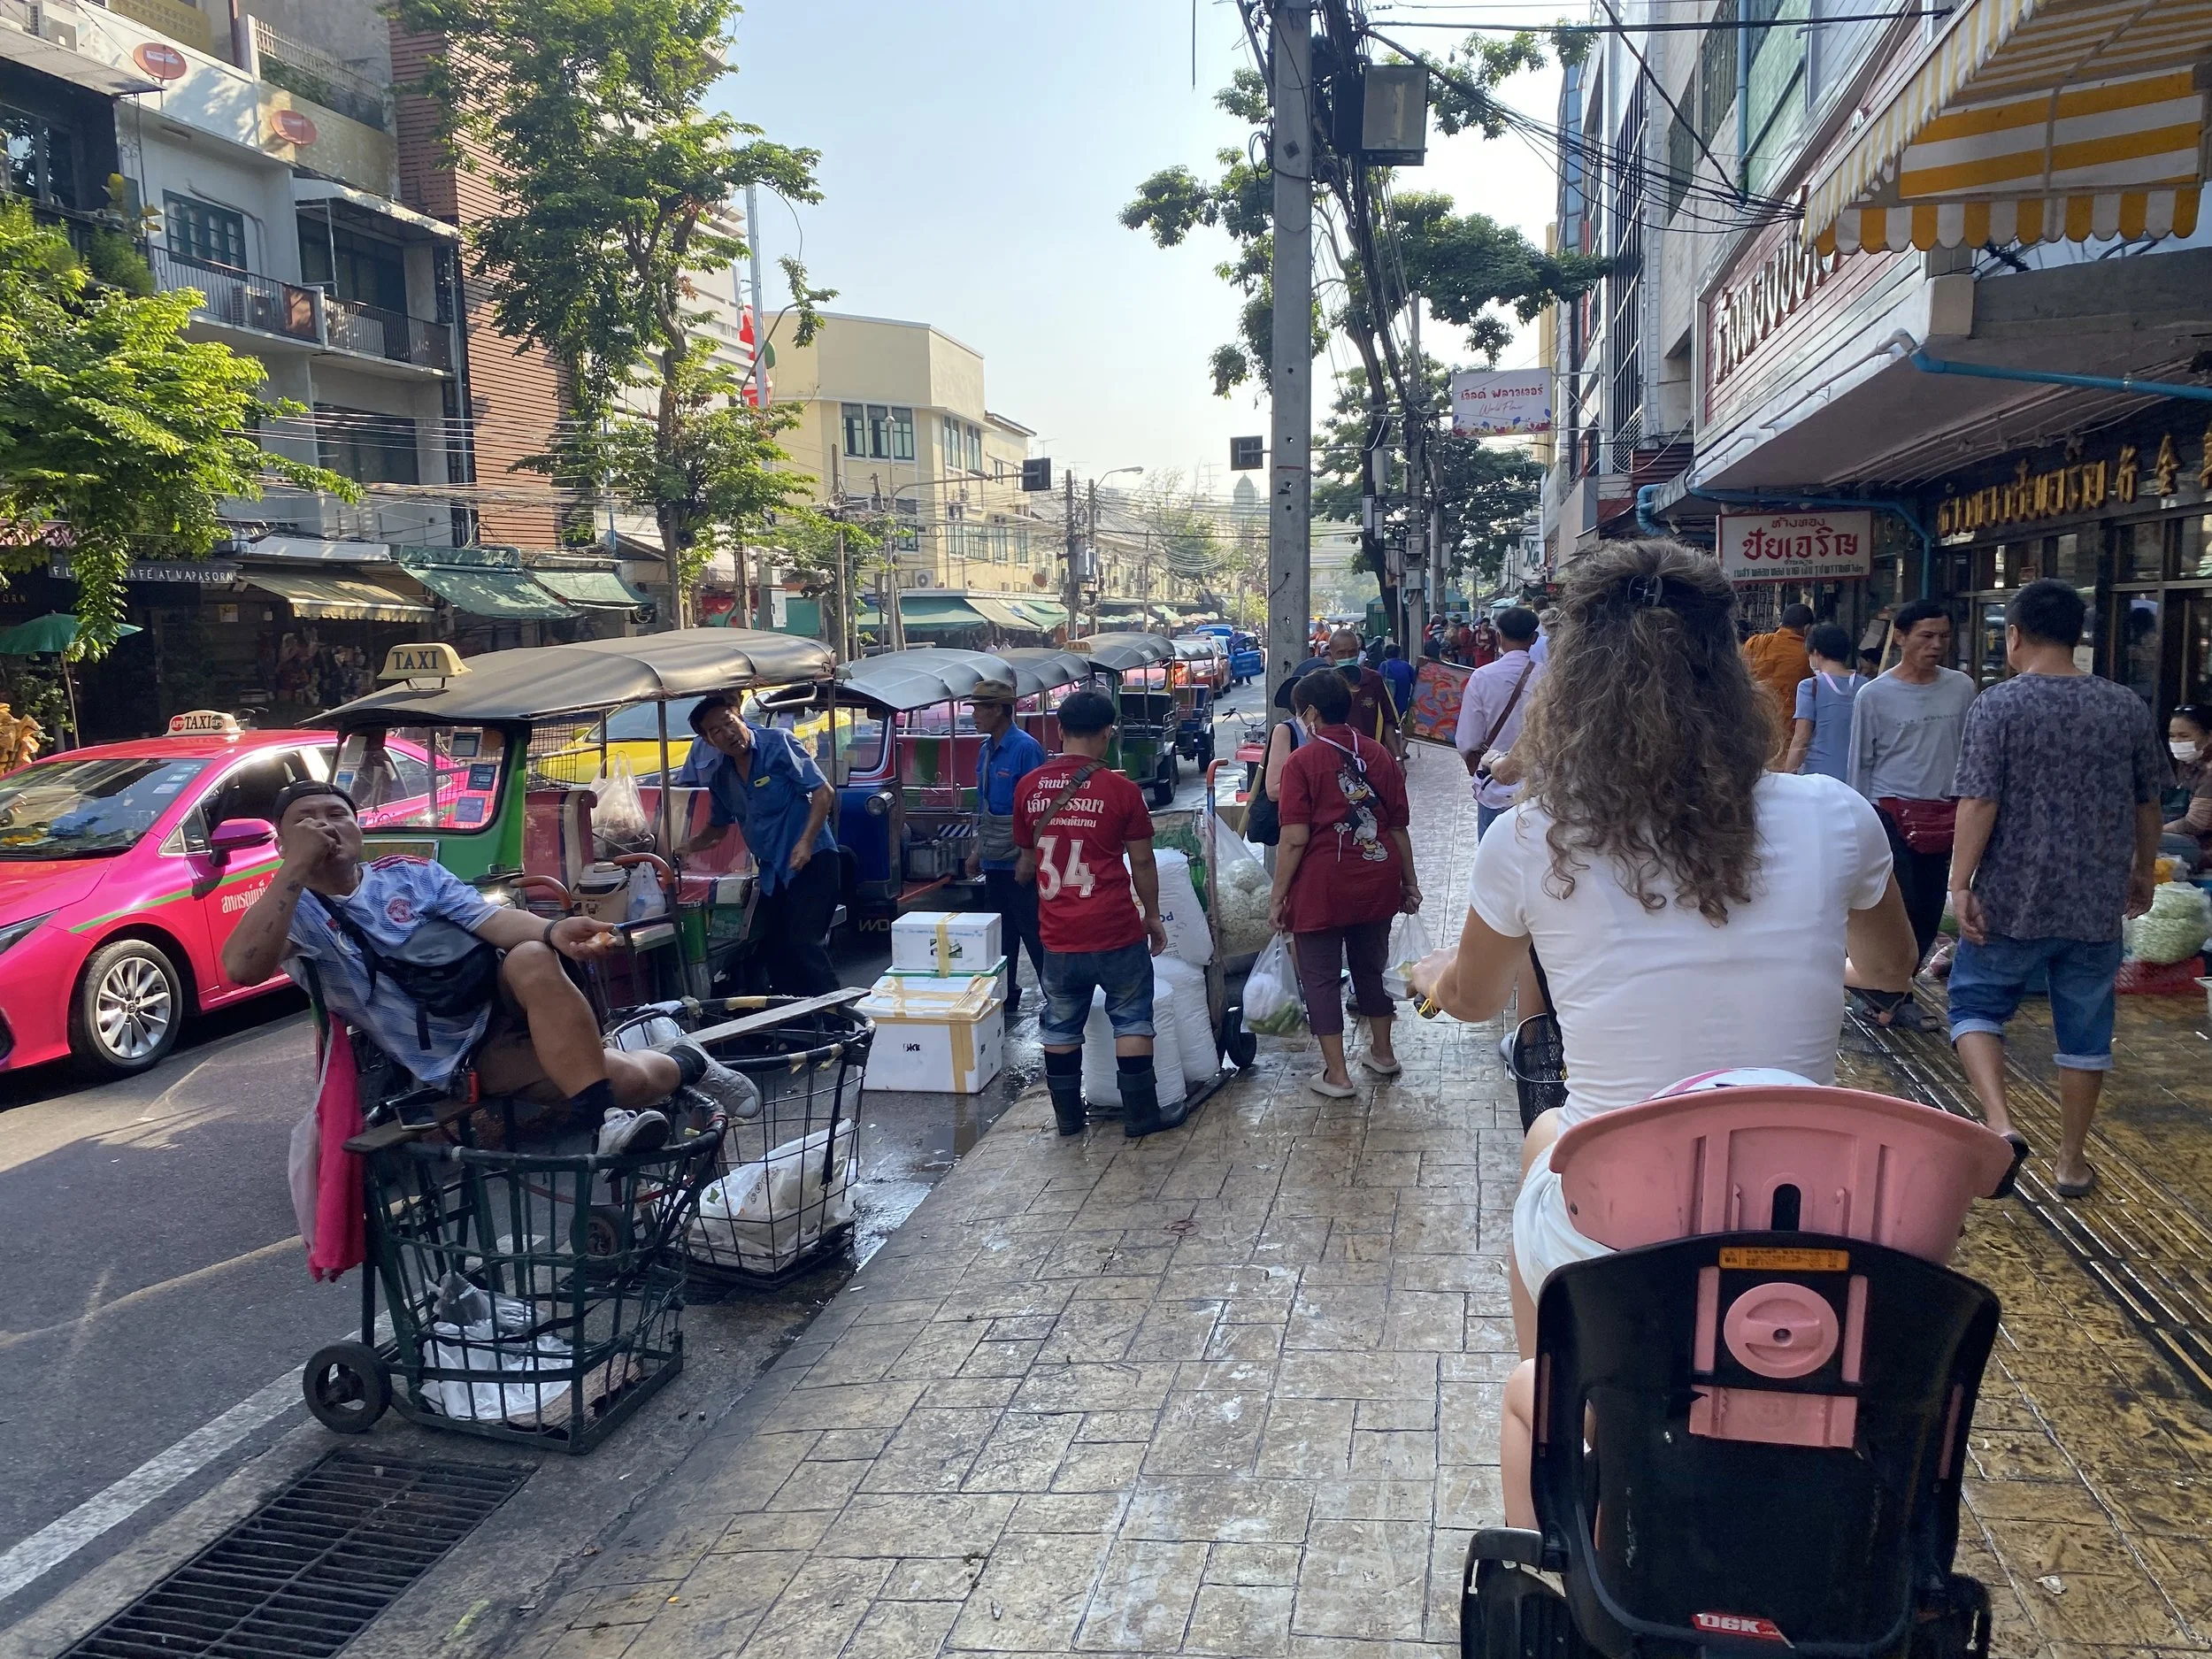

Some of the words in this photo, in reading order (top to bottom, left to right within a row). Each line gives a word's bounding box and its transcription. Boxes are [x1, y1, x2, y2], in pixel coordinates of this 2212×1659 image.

[1771, 518, 1826, 528] ห้างทอง
[1742, 526, 1858, 561] ชัยเจริญ
[158, 570, 172, 580] AT
[176, 570, 235, 582] NAPASORN
[392, 651, 439, 671] TAXI
[185, 715, 211, 729] TAXI
[1026, 792, 1105, 814] เล็กรรณา
[1036, 835, 1095, 902] 34
